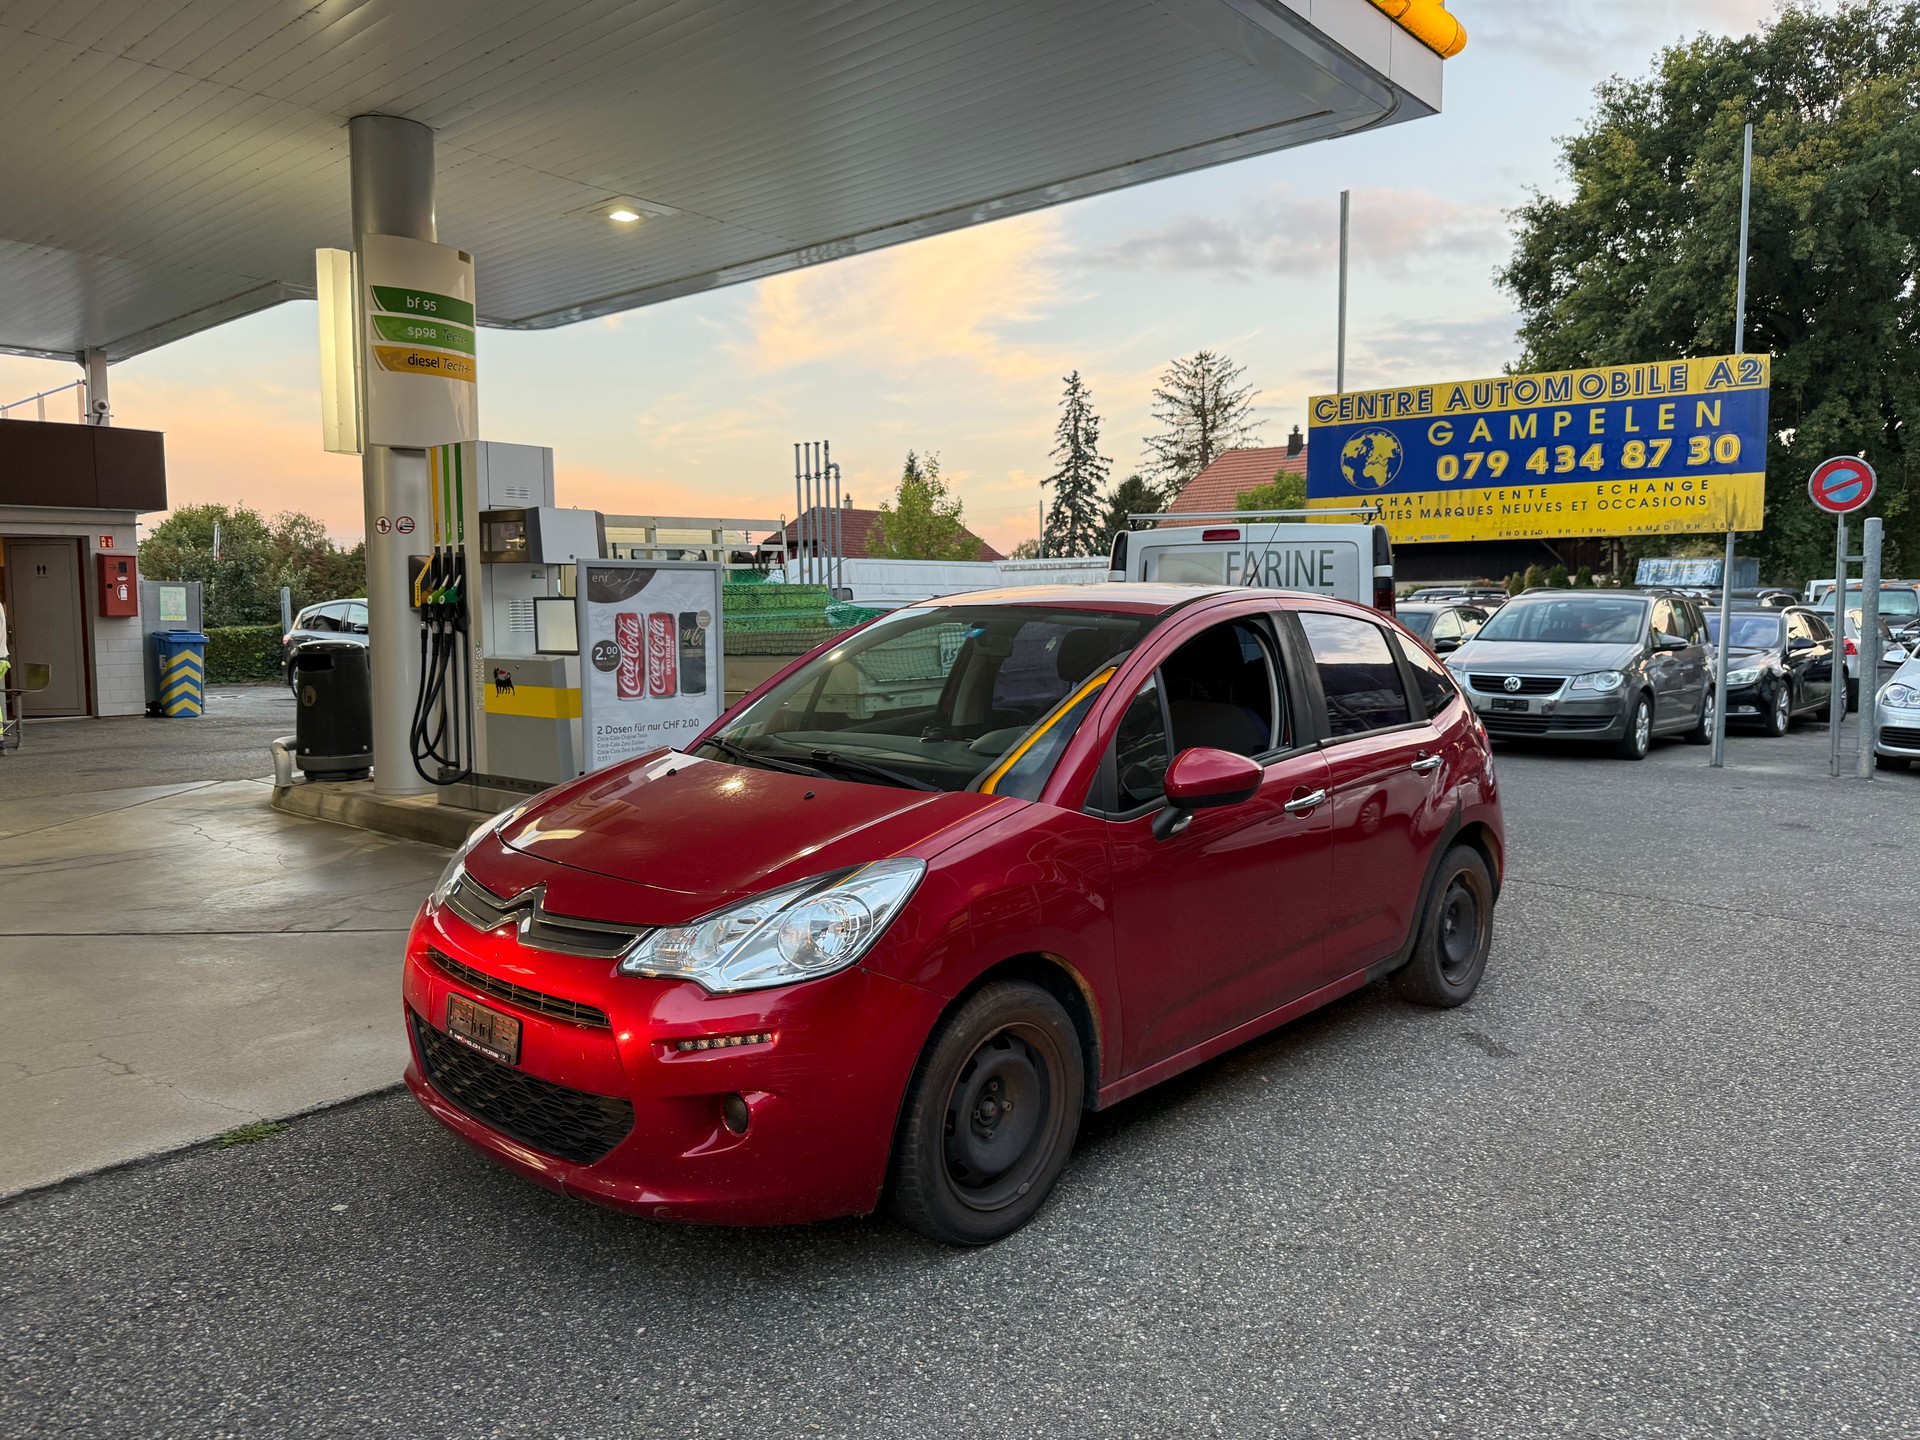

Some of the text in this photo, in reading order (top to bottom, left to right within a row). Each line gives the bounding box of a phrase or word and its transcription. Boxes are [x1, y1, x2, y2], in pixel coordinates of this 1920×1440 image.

[406, 296, 437, 312] bf 95
[407, 326, 437, 339] sp98
[407, 353, 471, 373] diesel Tech+
[1314, 356, 1763, 423] CENTRE AUTOMOBILE A2
[1427, 399, 1722, 446] GAMPELEN
[1436, 433, 1741, 482] 079 434 87 30
[1360, 479, 1709, 508] ACHAT VENTE ECHANGE
[1420, 504, 1494, 519] MARQUES
[1502, 501, 1562, 515] NEUVES
[1571, 500, 1588, 512] ET
[1597, 494, 1707, 510] OCCASIONS
[1226, 550, 1335, 587] FARINE
[595, 646, 618, 661] 2.00
[597, 718, 700, 735] 2 Dosen für nur CHF 2.00
